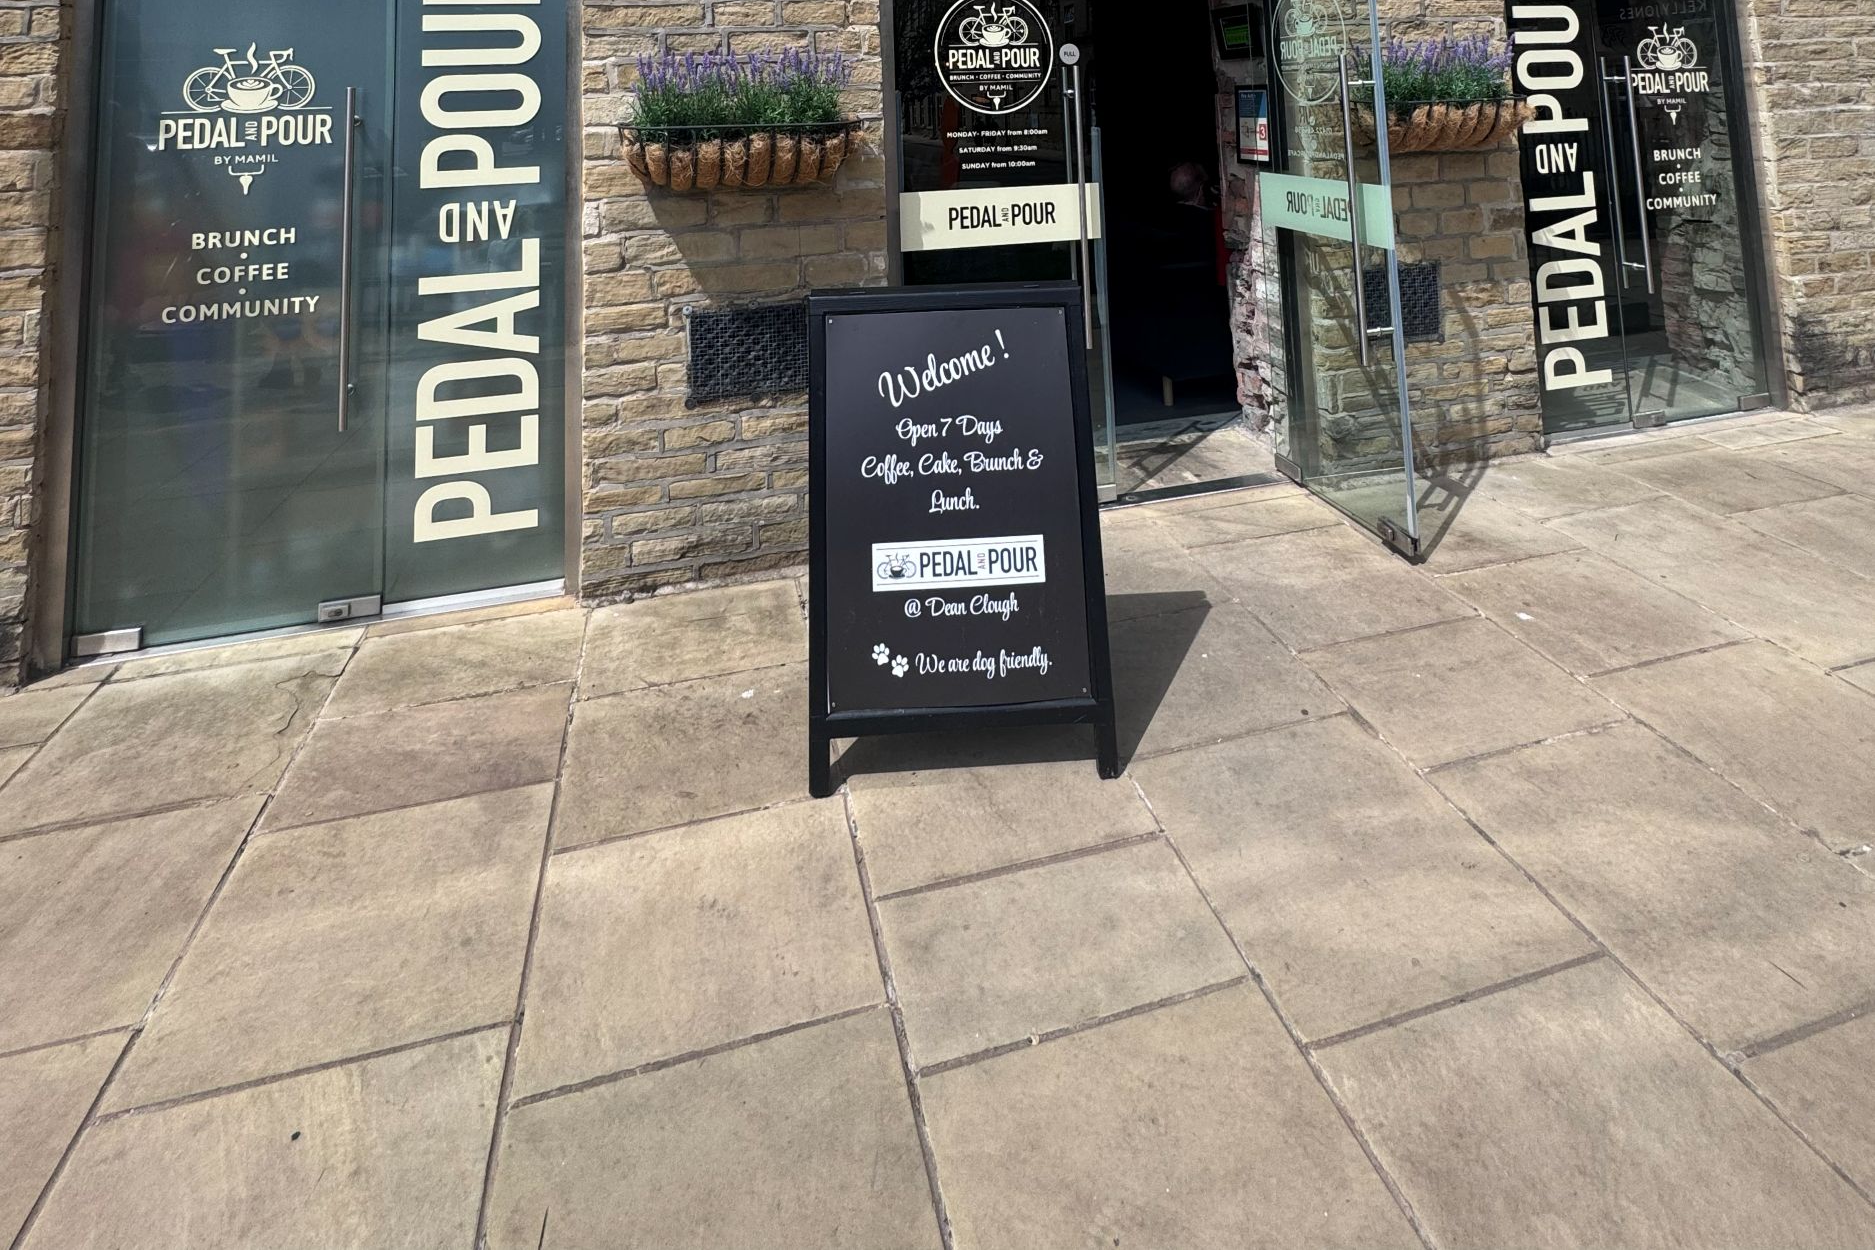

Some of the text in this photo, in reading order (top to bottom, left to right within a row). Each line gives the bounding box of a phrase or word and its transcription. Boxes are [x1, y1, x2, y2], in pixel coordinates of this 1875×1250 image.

[949, 49, 994, 69] PEDAL
[1001, 48, 1040, 68] POUR
[1631, 73, 1671, 94] PEDAL
[1675, 71, 1710, 93] POUR
[158, 114, 333, 150] PEDAL AND POUR
[214, 154, 279, 165] BY MAMIL
[959, 146, 995, 154] SATURDAY
[1535, 141, 1578, 174] AND
[1653, 147, 1701, 161] BRUNCH
[962, 162, 990, 170] SUNDAY
[1659, 171, 1701, 185] COFFEE
[948, 202, 1056, 230] PEDAL AND POUR
[1646, 194, 1717, 210] COMMUNITY
[439, 199, 517, 244] AND
[191, 227, 296, 250] BRUNCH
[197, 262, 289, 285] COFFEE
[1529, 171, 1613, 390] PEDAL
[162, 295, 320, 324] COMMUNITY
[414, 238, 541, 543] PEDAL
[895, 415, 1003, 447] Open 7 Days
[861, 448, 1043, 484] Coffee, Cake, Brunch &
[929, 487, 980, 514] Lunch.
[920, 546, 1038, 578] PEDAL AND POUR
[904, 591, 1019, 621] @ Dean Clough
[915, 645, 1053, 679] We are dog friendly.
